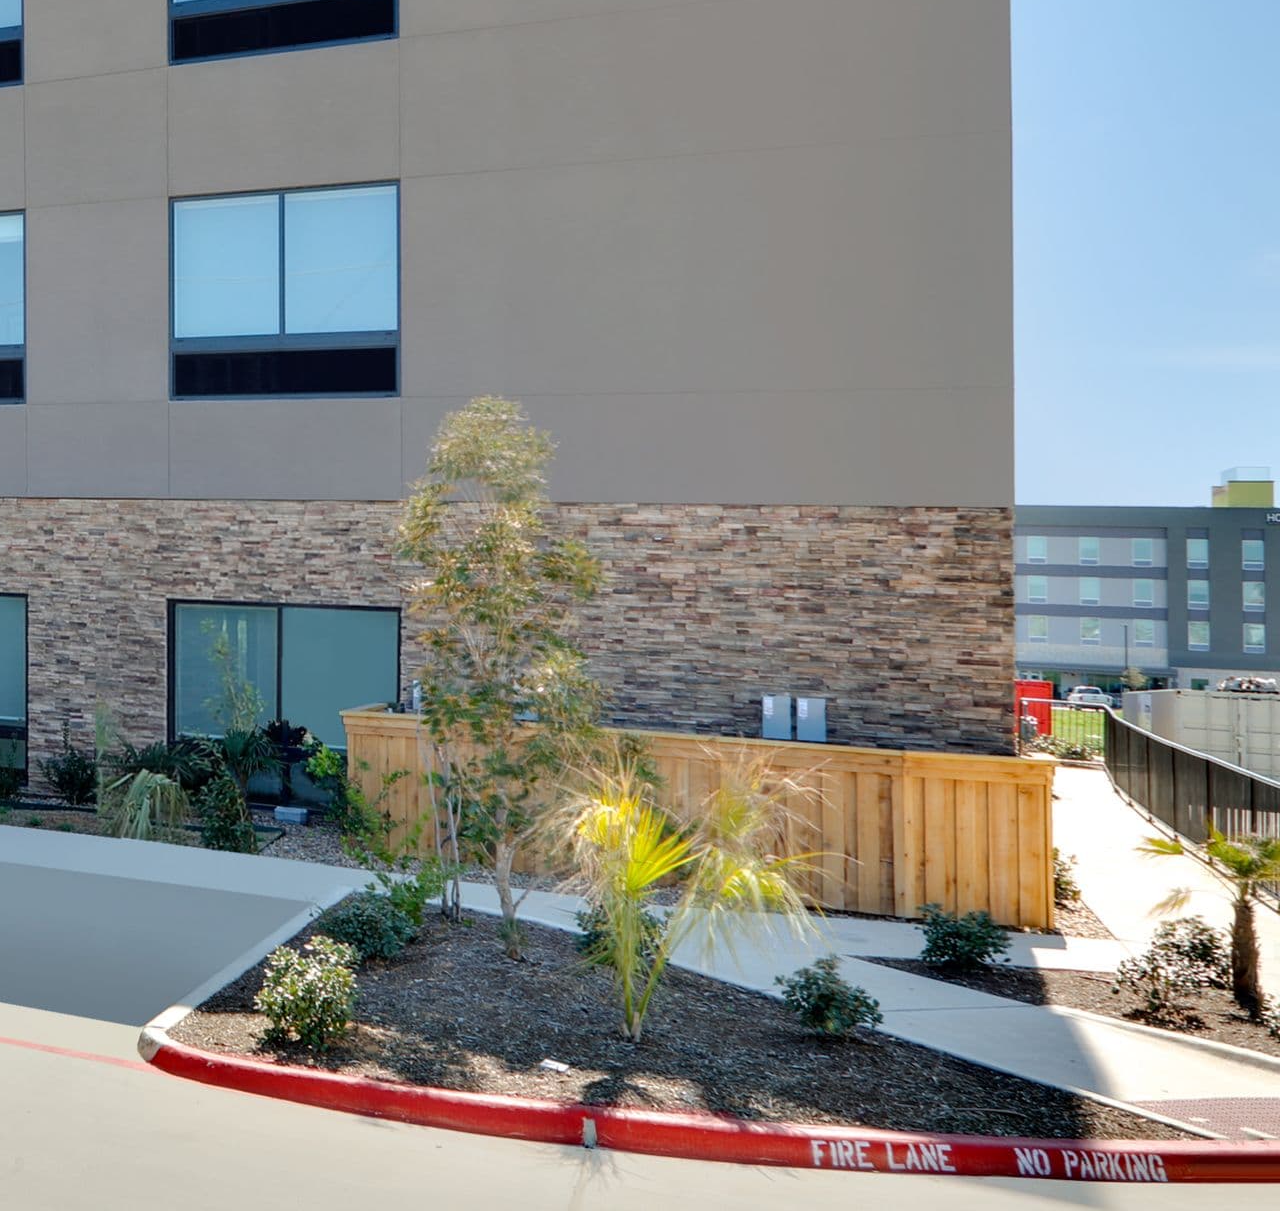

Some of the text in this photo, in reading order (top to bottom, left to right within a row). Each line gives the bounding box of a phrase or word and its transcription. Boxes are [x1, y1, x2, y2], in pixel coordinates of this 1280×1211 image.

[810, 1139, 1169, 1183] FIRE LANE NO PARKING
